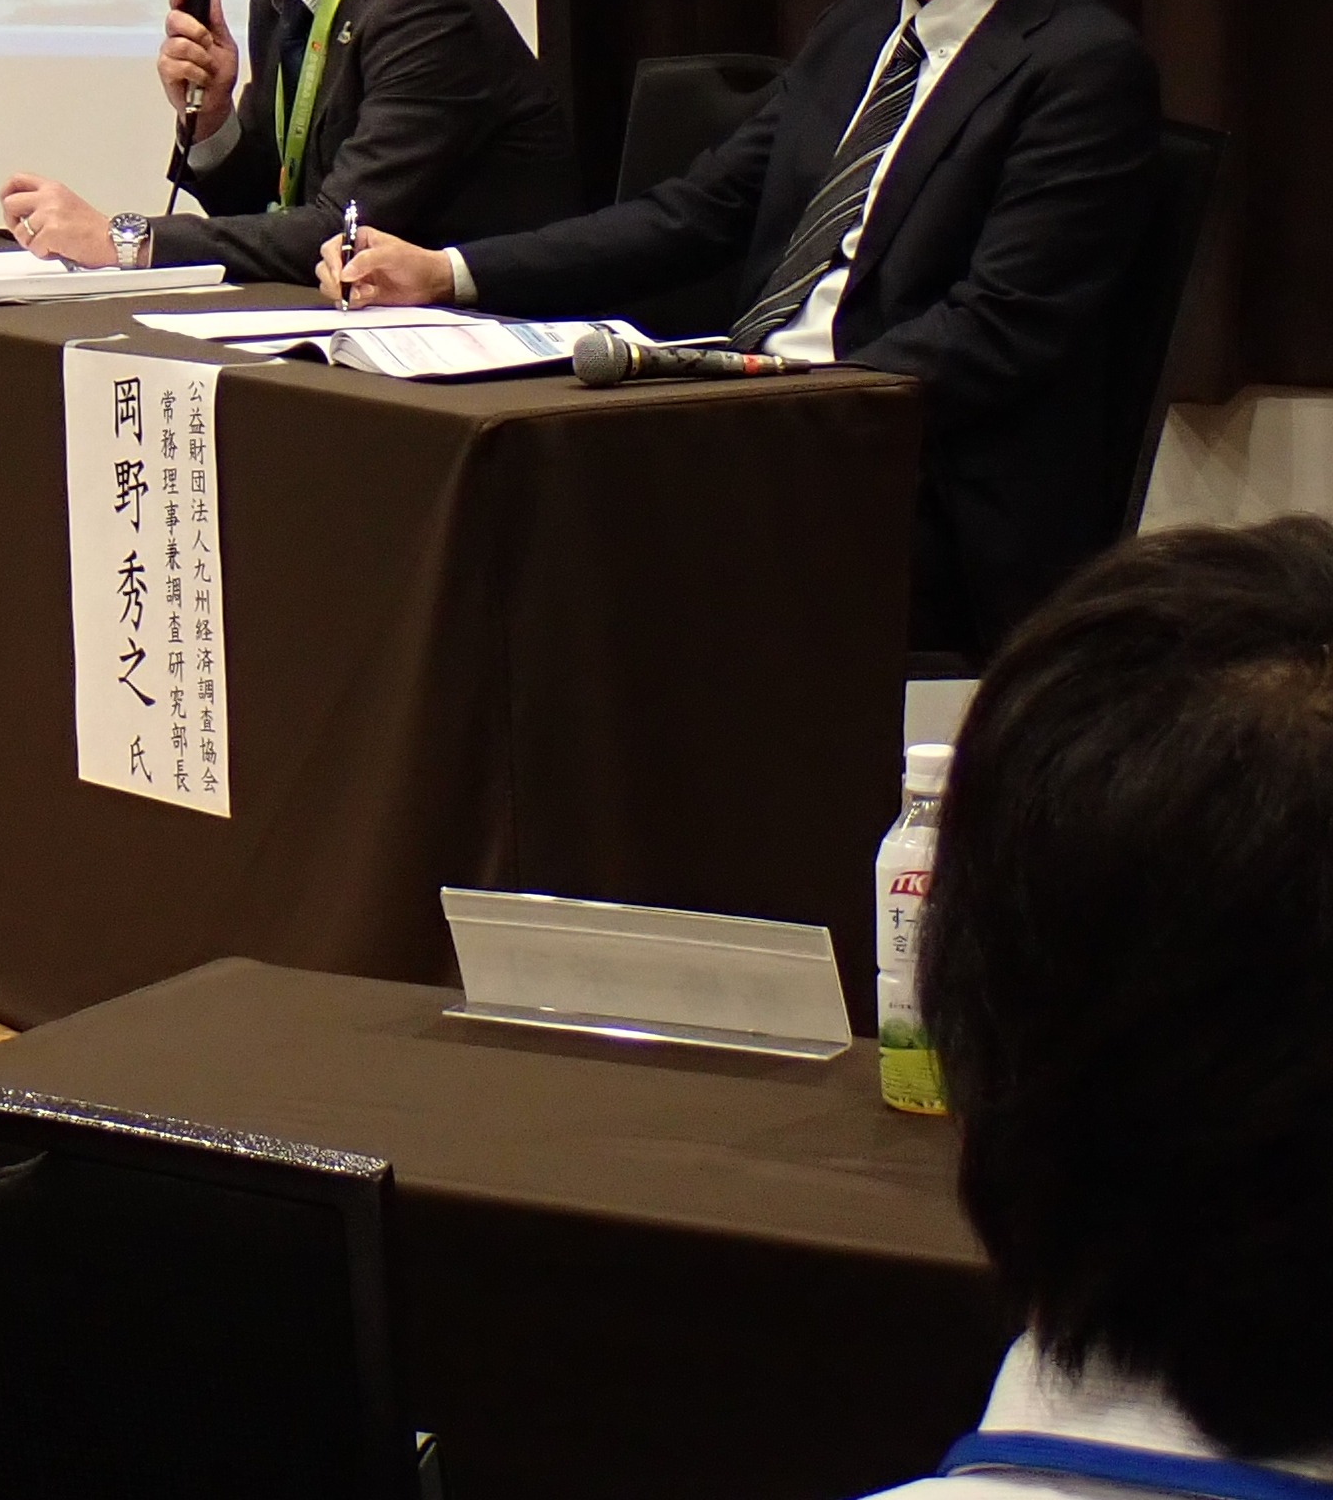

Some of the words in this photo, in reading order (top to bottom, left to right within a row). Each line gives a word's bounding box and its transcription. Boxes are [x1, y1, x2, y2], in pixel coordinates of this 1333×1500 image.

[159, 391, 190, 793] 常務理事兼調査研究部長
[187, 380, 218, 794] 公益財団法人九州経済調査協会
[892, 873, 929, 895] TK
